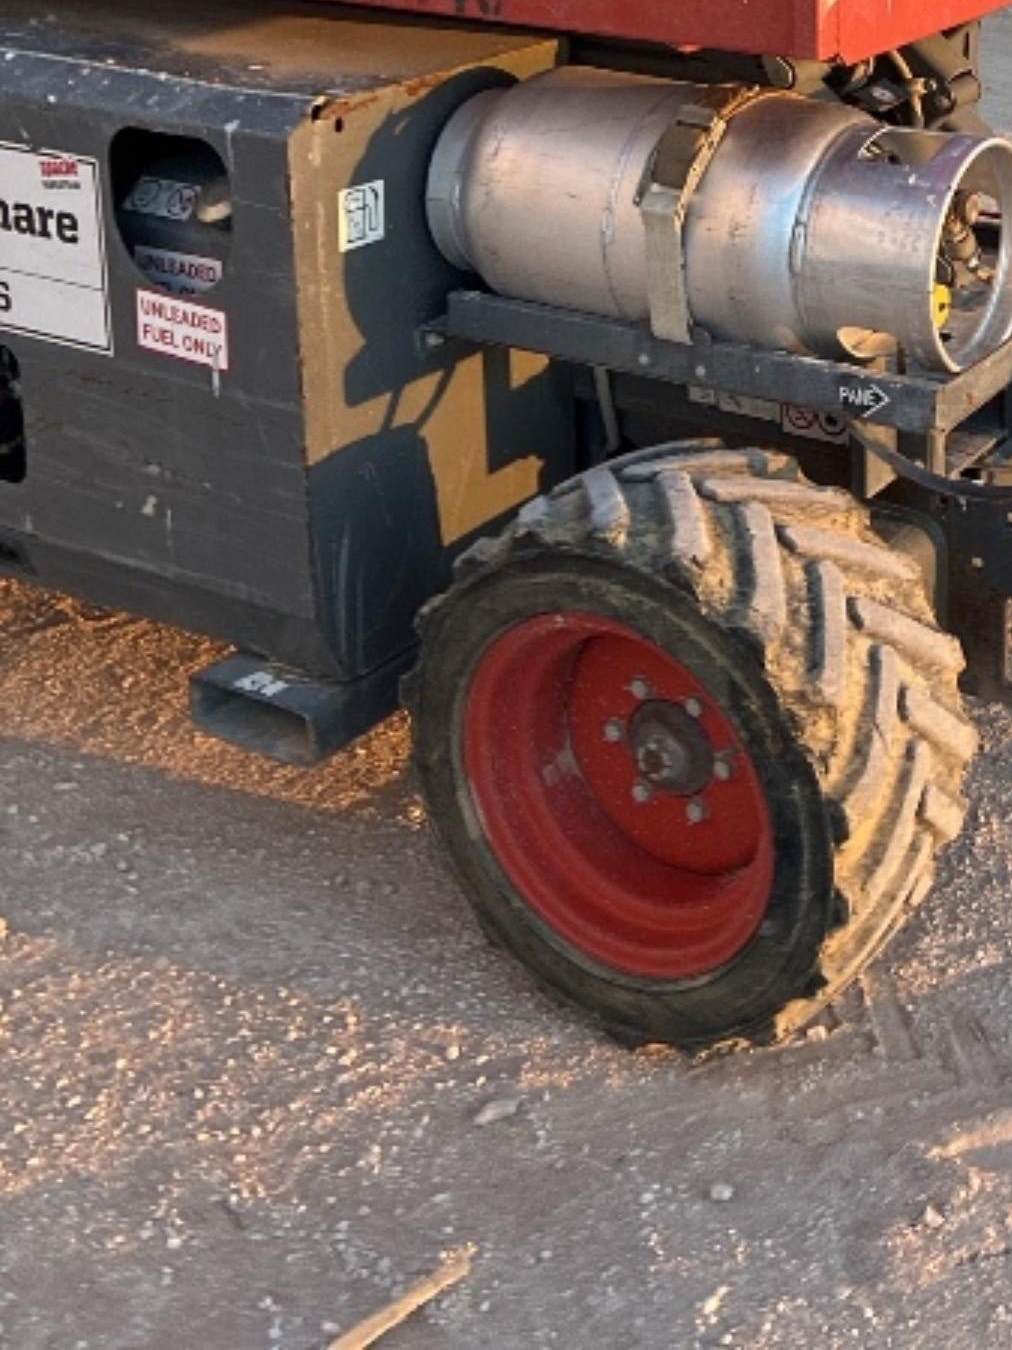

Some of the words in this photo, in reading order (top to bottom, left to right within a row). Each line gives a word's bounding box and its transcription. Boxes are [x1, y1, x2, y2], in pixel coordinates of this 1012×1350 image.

[140, 297, 222, 334] UNLEADED
[143, 323, 179, 348] FUEL
[182, 335, 222, 357] ONLY
